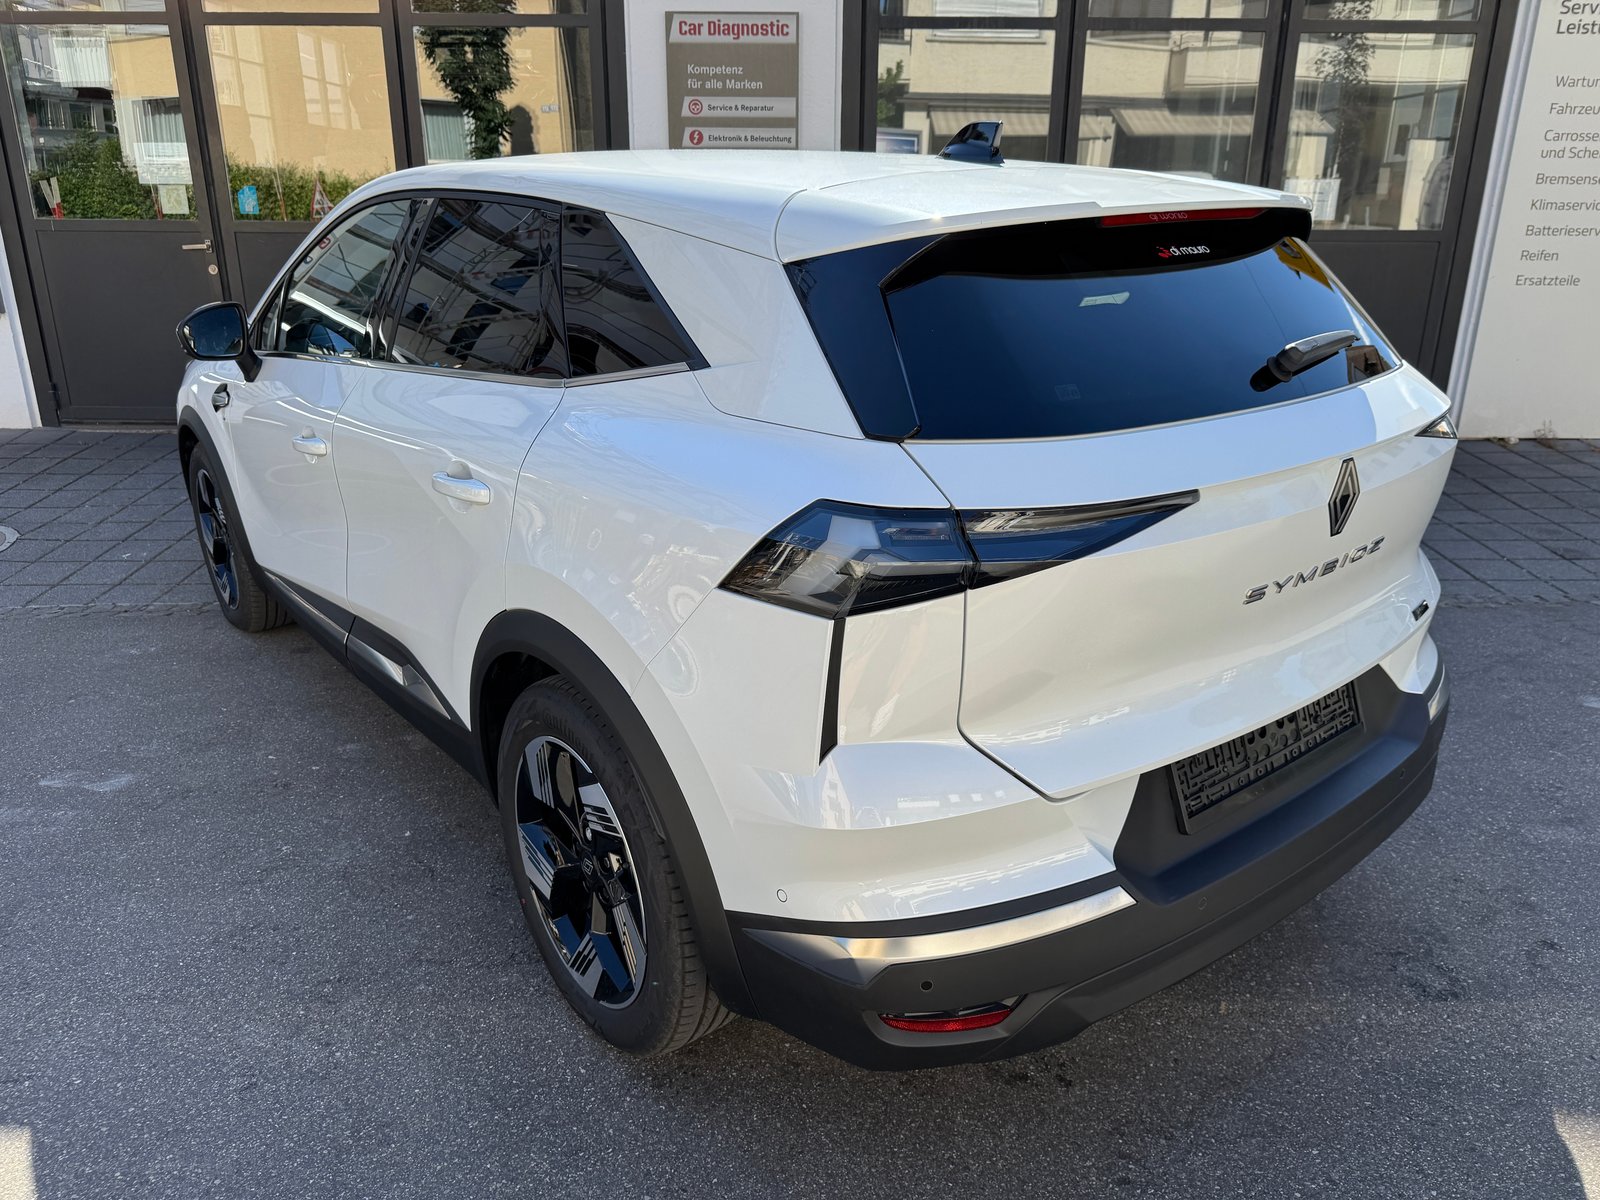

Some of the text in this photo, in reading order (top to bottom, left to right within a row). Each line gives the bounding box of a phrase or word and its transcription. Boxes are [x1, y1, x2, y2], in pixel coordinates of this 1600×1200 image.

[1560, 0, 1600, 15] Serv
[678, 19, 790, 40] Car Diagnostic
[1556, 19, 1600, 35] Leist
[687, 64, 743, 76] Kompetenz
[687, 78, 763, 90] für alle Marken
[707, 104, 774, 113] Service & Reparatur
[1549, 103, 1600, 115] Fahrzeu
[708, 135, 792, 144] Elektronik & Beleuchtung
[1544, 129, 1600, 142] Carrosse
[1541, 147, 1600, 159] und Sche
[1536, 173, 1600, 185] Bremsens
[1530, 199, 1600, 211] Klimaservic
[1525, 224, 1600, 237] Batterieserv
[1180, 245, 1210, 256] mauro
[1520, 249, 1559, 261] Reifen
[1515, 275, 1580, 286] Ersatzteile
[1242, 535, 1386, 606] SYMBIOZ
